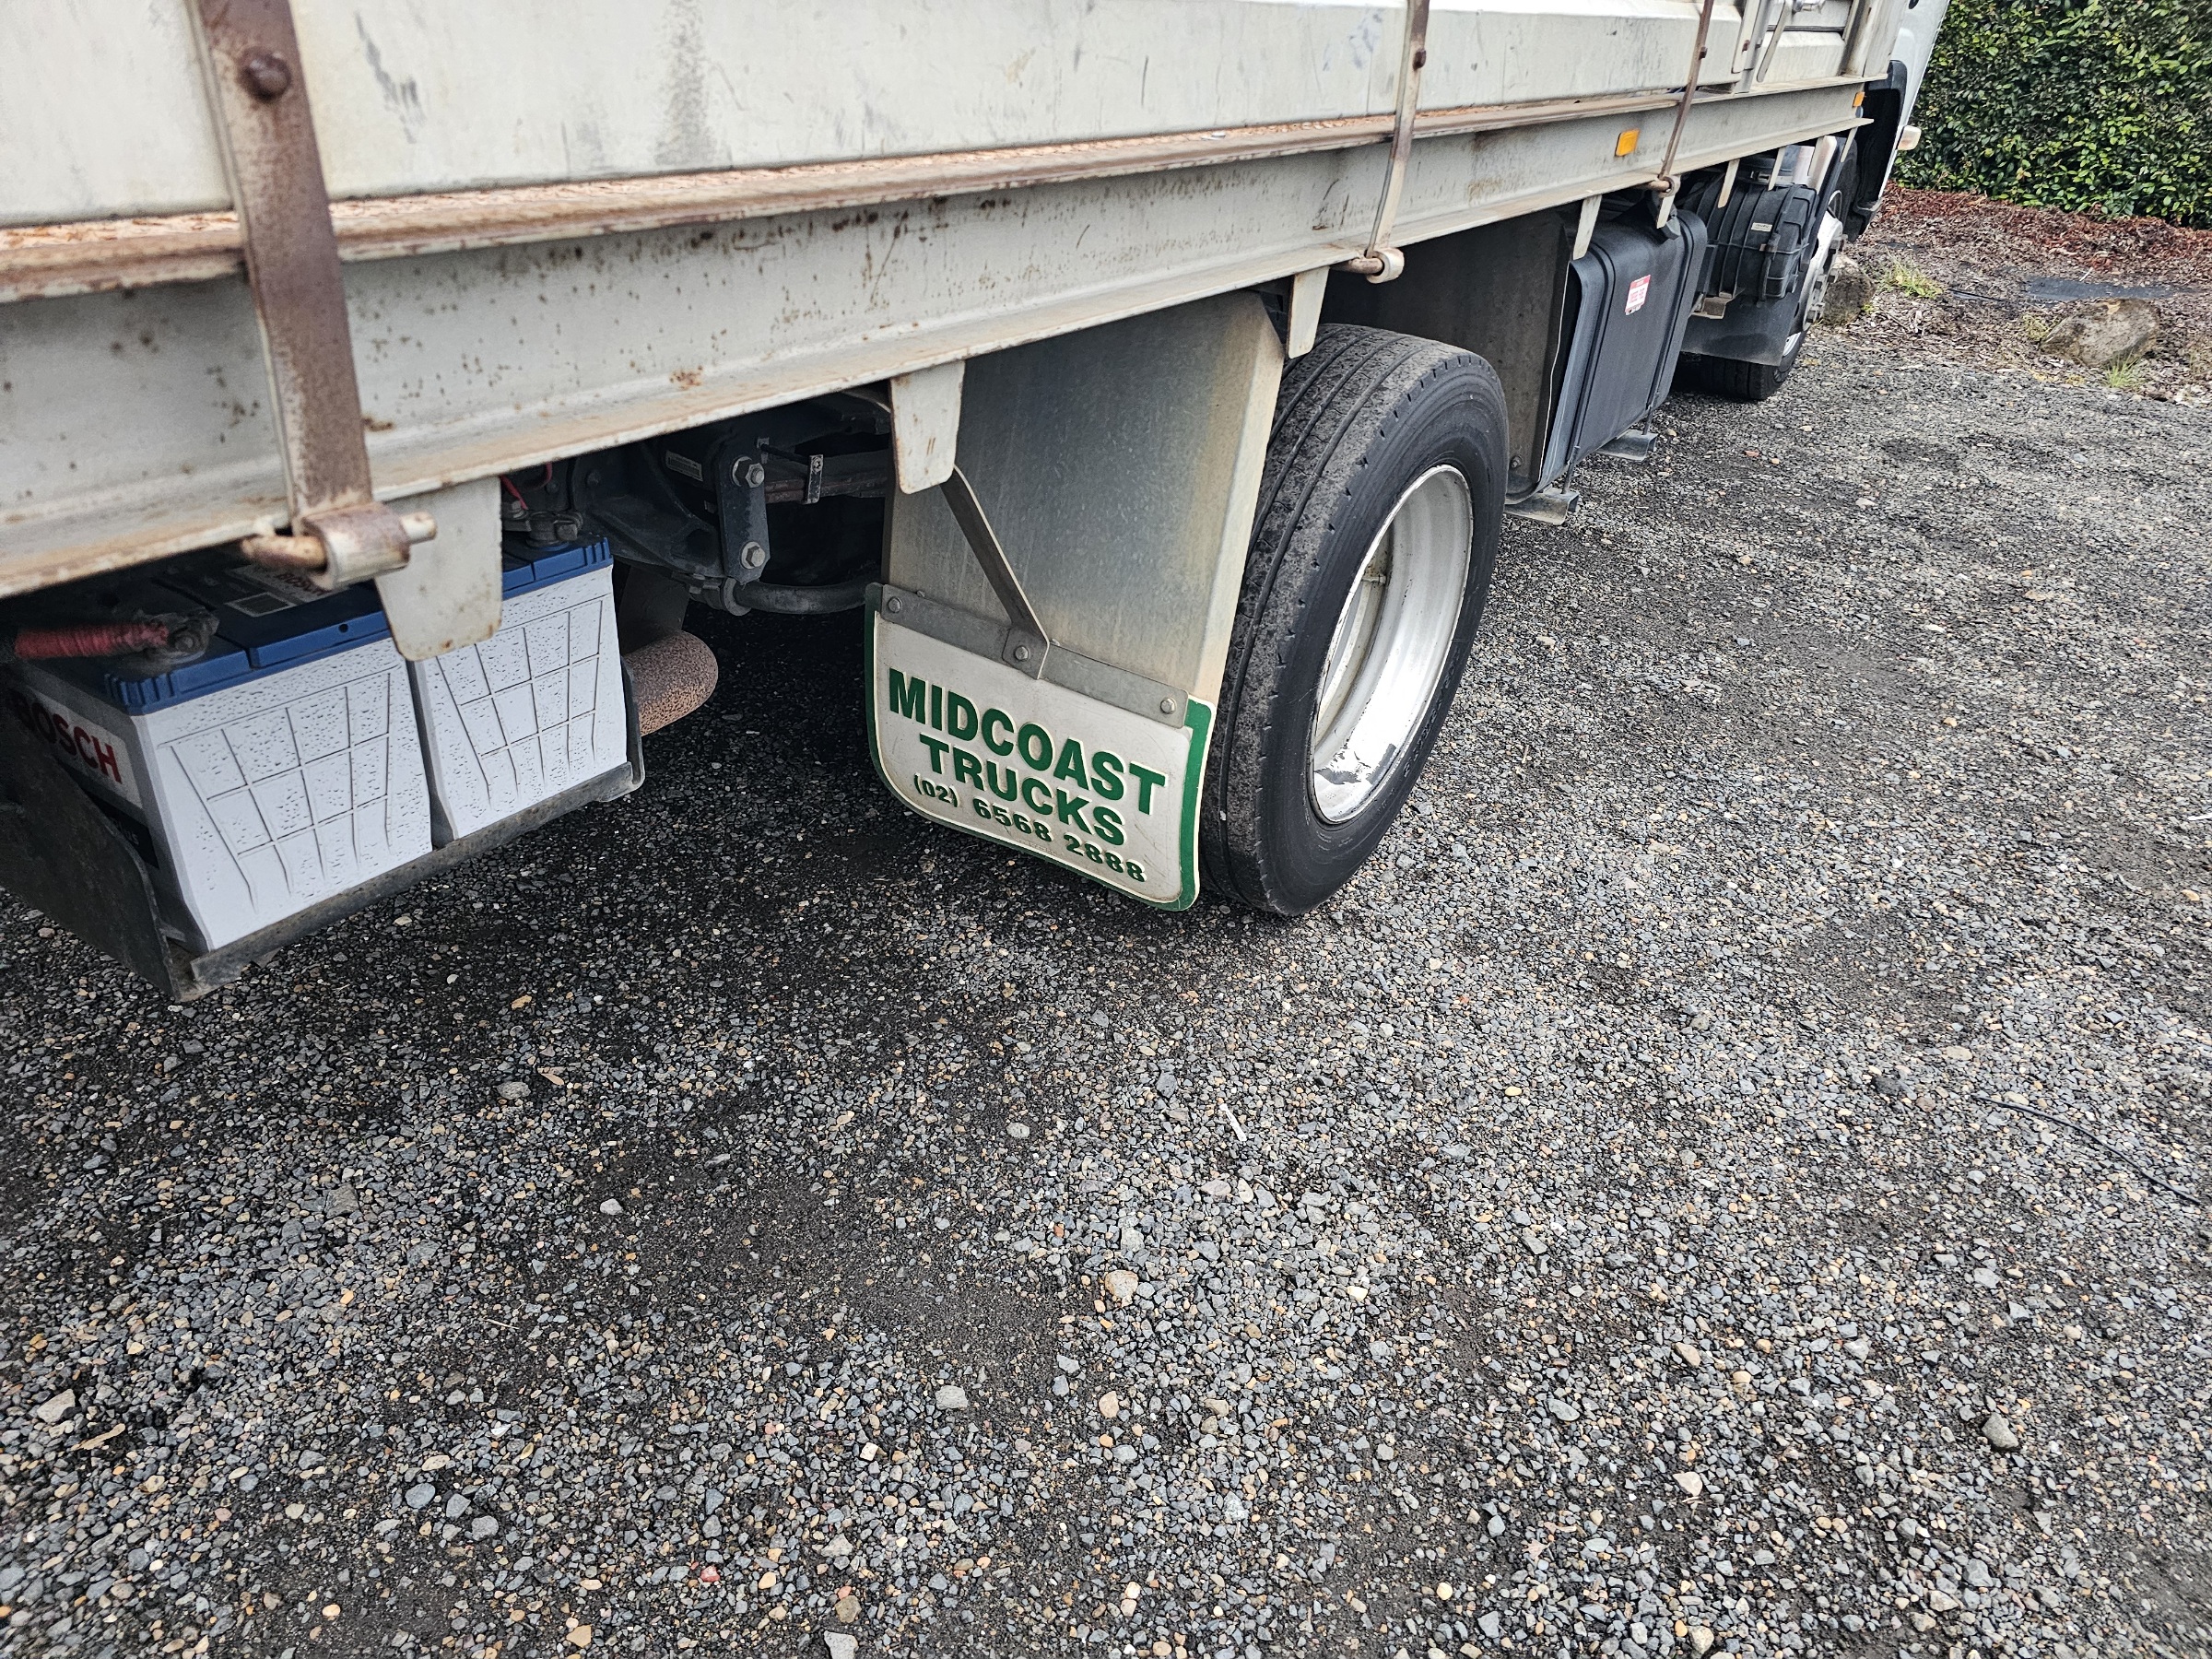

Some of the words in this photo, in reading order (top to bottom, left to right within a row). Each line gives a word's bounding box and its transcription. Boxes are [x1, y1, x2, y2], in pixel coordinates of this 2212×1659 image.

[888, 666, 1168, 816] MIDCOAST
[919, 733, 1126, 846] TRUCKS
[913, 773, 959, 807] (02)
[972, 797, 1053, 842] 6568
[1064, 832, 1147, 883] 2888
